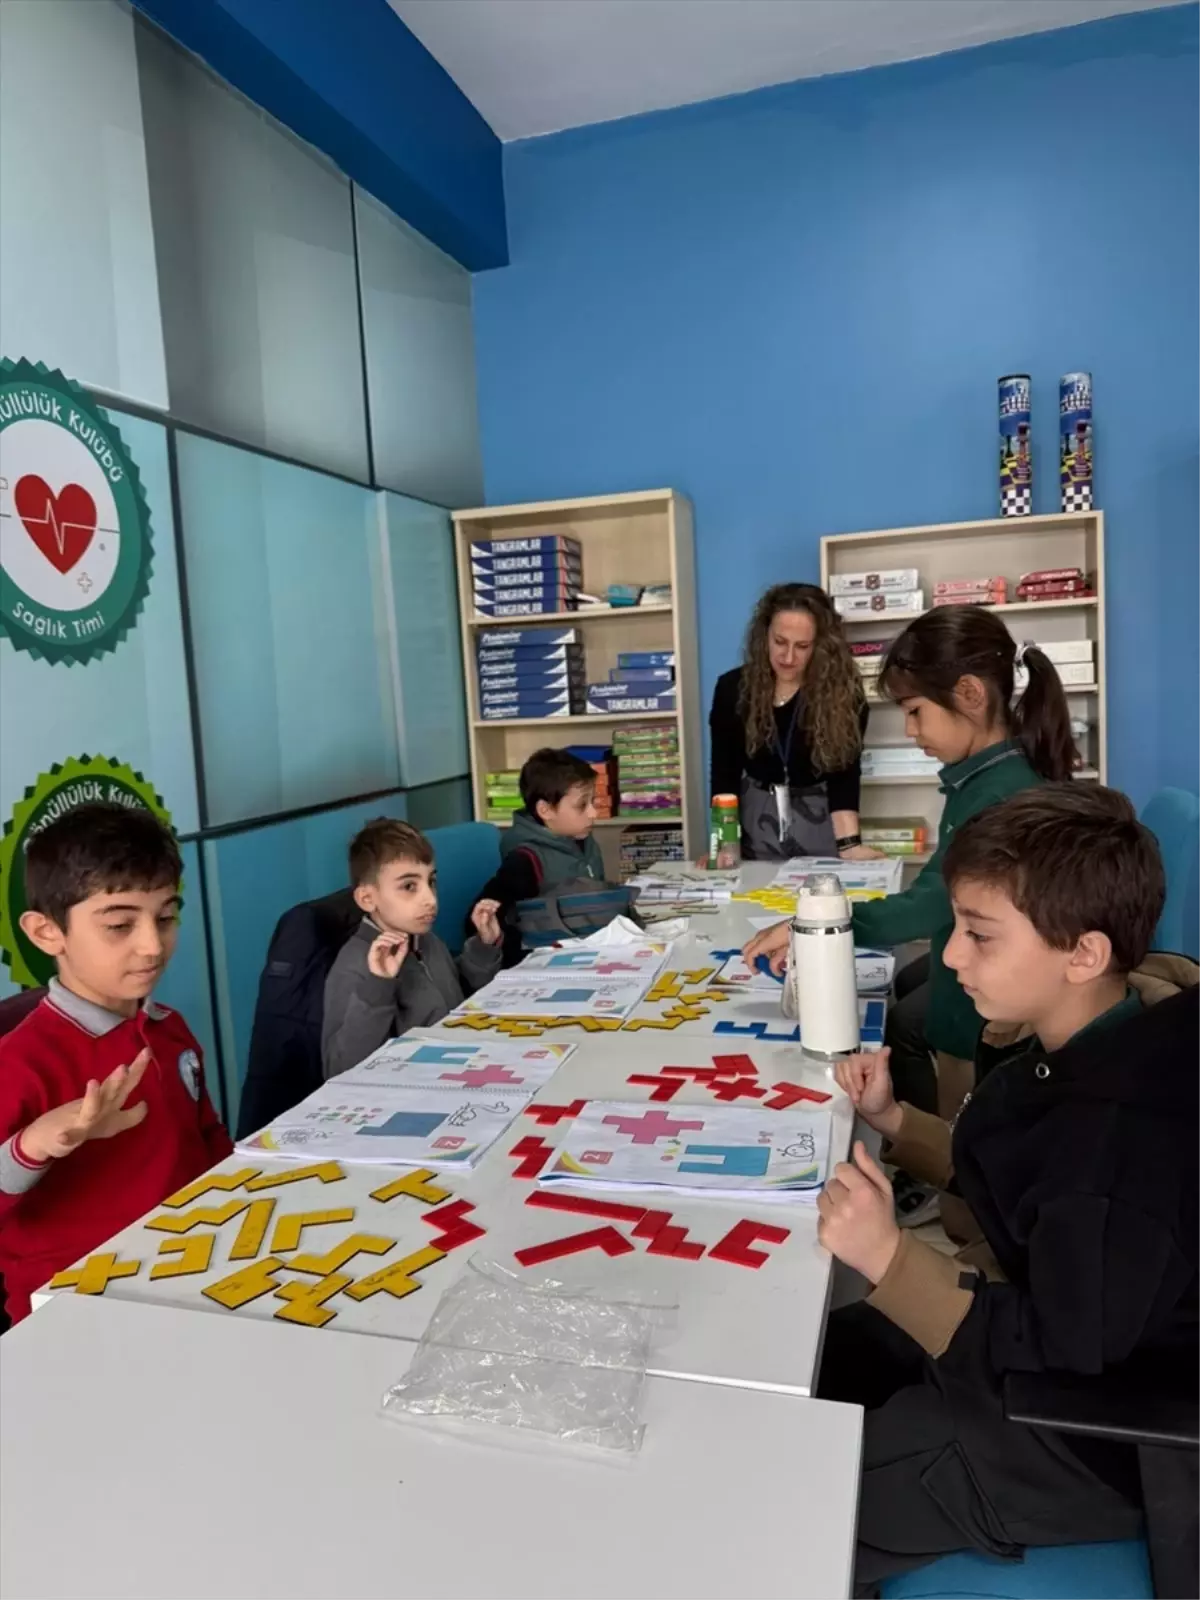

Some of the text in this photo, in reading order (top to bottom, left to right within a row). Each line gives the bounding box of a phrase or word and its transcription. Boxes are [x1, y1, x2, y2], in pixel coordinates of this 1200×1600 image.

[0, 389, 124, 483] üllülük Kulübü
[491, 538, 542, 554] TANGRAMLAR
[492, 555, 543, 571] TANGRAMLAR
[494, 571, 544, 587] TANGRAMLAR
[494, 587, 544, 602] TANGRAMLAR
[494, 602, 543, 618] TANGRAMLAR
[12, 601, 106, 639] Sağlık Timi
[607, 697, 659, 711] TANGRAMLAR
